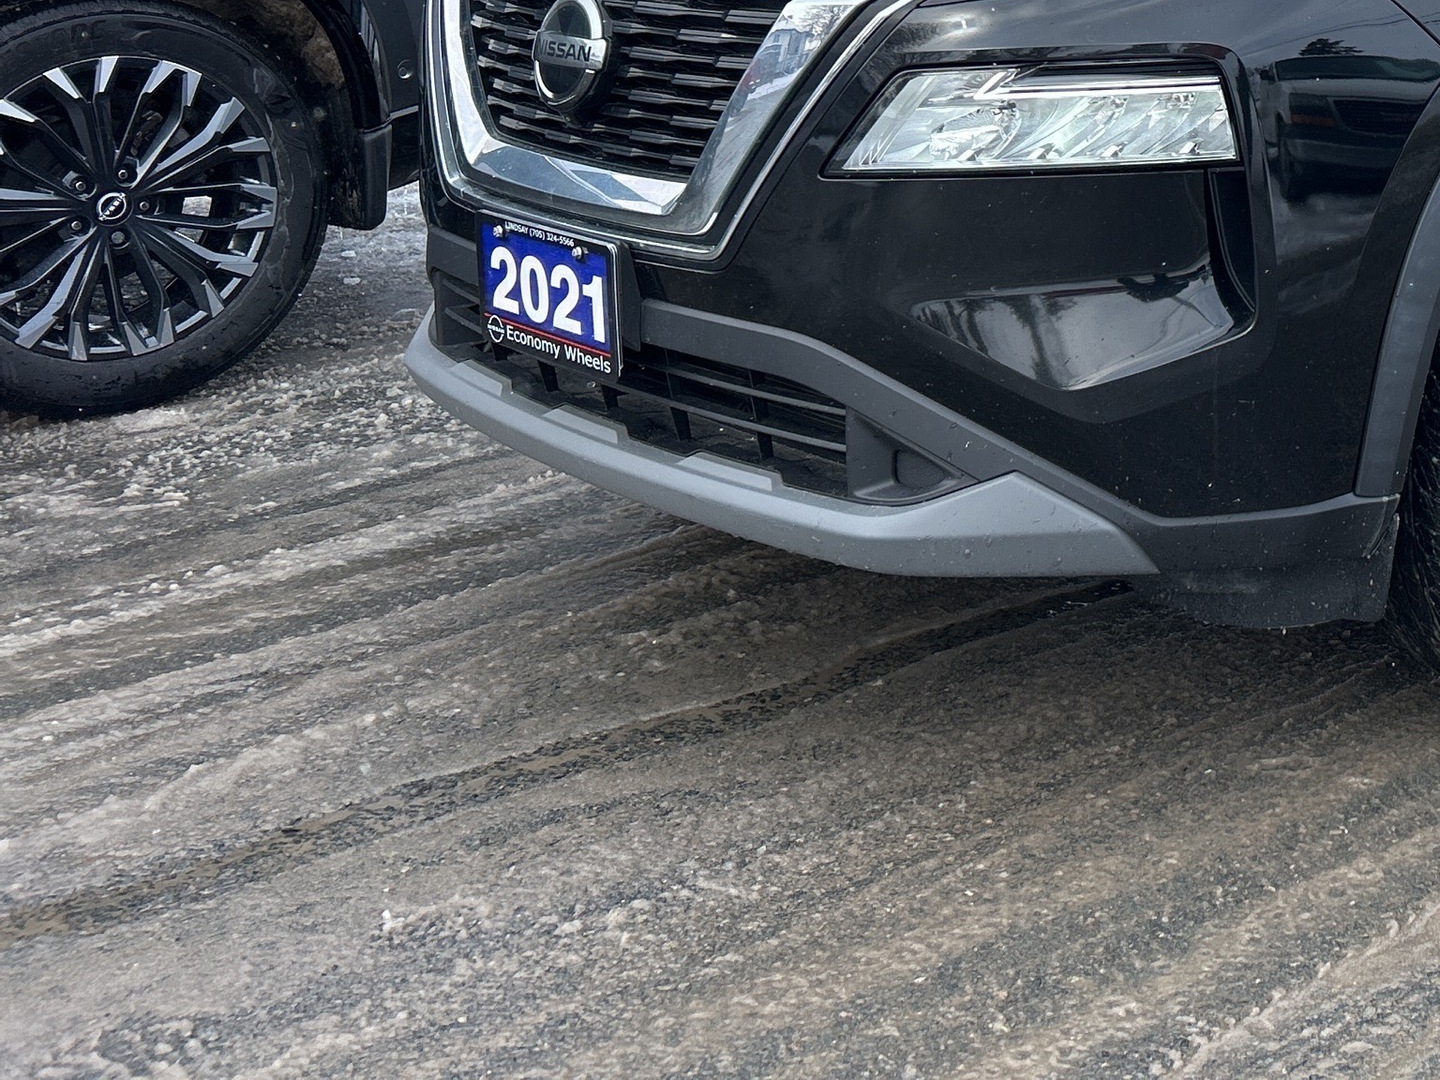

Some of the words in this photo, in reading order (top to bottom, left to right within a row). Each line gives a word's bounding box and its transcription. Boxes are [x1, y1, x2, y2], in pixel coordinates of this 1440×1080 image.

[538, 38, 592, 62] NISSAN
[504, 220, 529, 234] LINDSAY
[529, 228, 546, 241] (705)
[546, 232, 575, 247] 324-5566
[490, 246, 606, 343] 2021
[506, 324, 561, 359] Economy
[563, 343, 612, 374] Wheels
